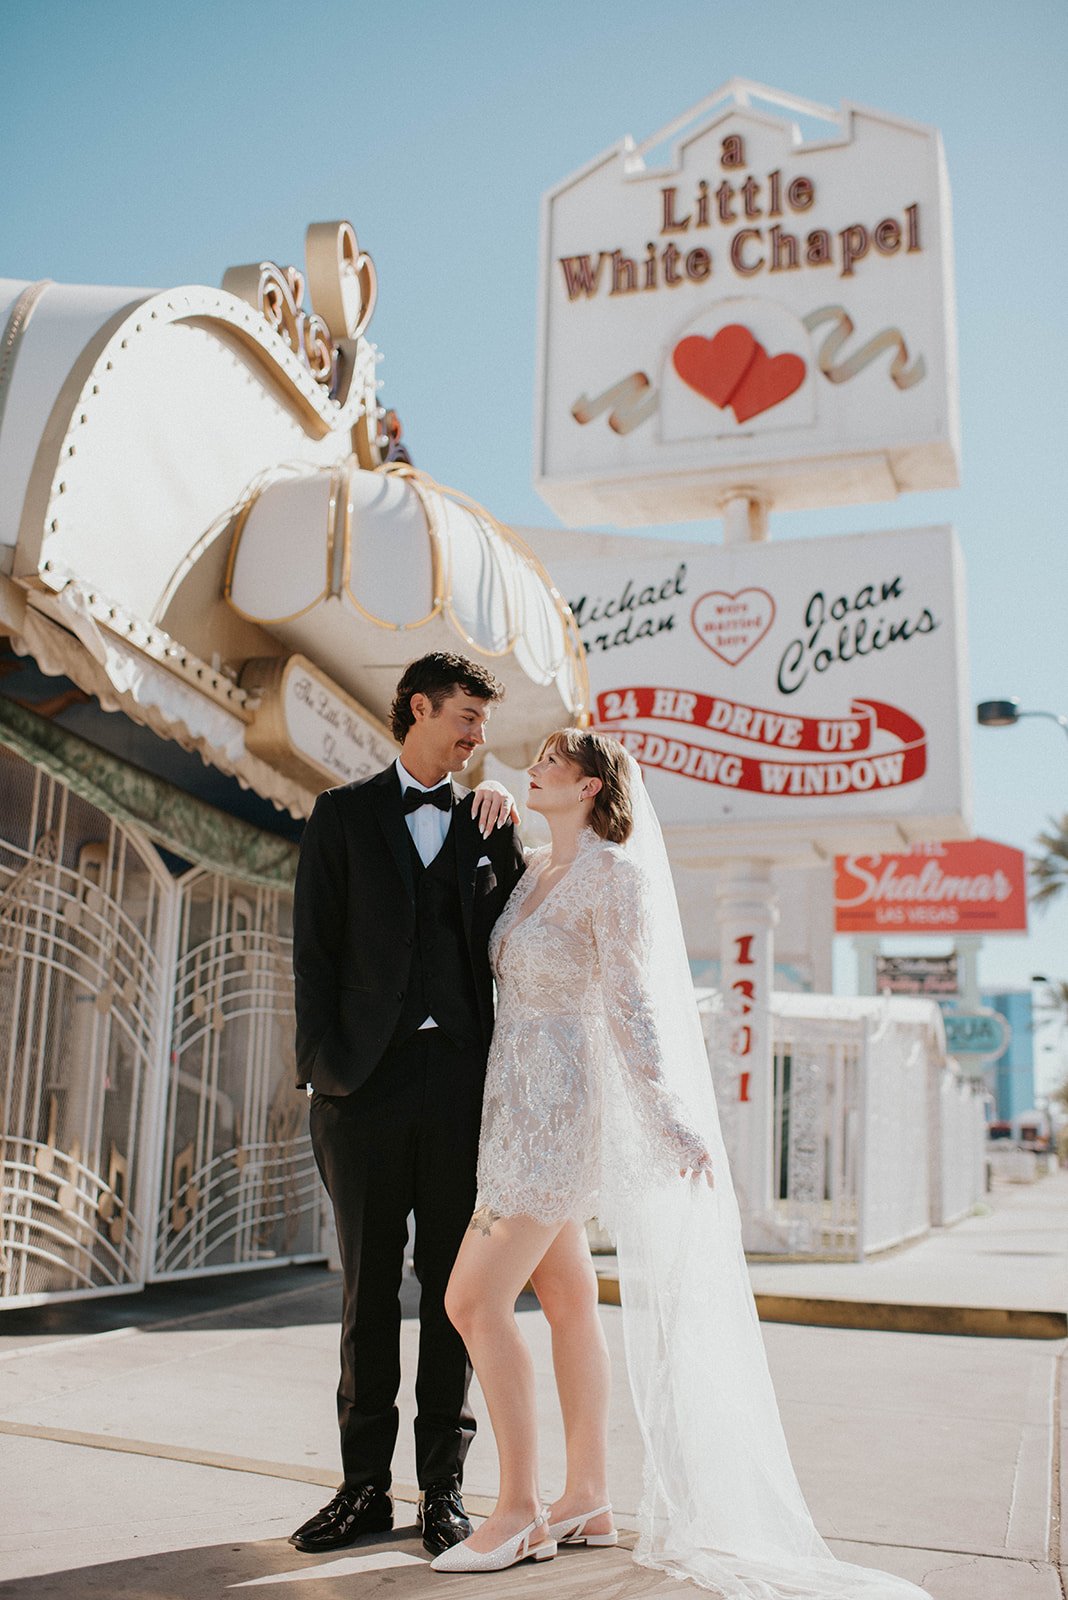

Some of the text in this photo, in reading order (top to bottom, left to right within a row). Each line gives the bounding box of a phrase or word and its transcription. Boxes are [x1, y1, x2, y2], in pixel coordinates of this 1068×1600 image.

[720, 134, 746, 169] a
[659, 169, 816, 236] Little
[559, 203, 922, 302] White Chapel
[805, 575, 904, 649] Joan
[777, 608, 941, 695] Collins
[603, 688, 862, 751] 24 HR DRIVE UP
[759, 753, 905, 795] WINDOW
[832, 850, 1013, 908] Shalimar
[875, 905, 960, 925] LAS VEGAS
